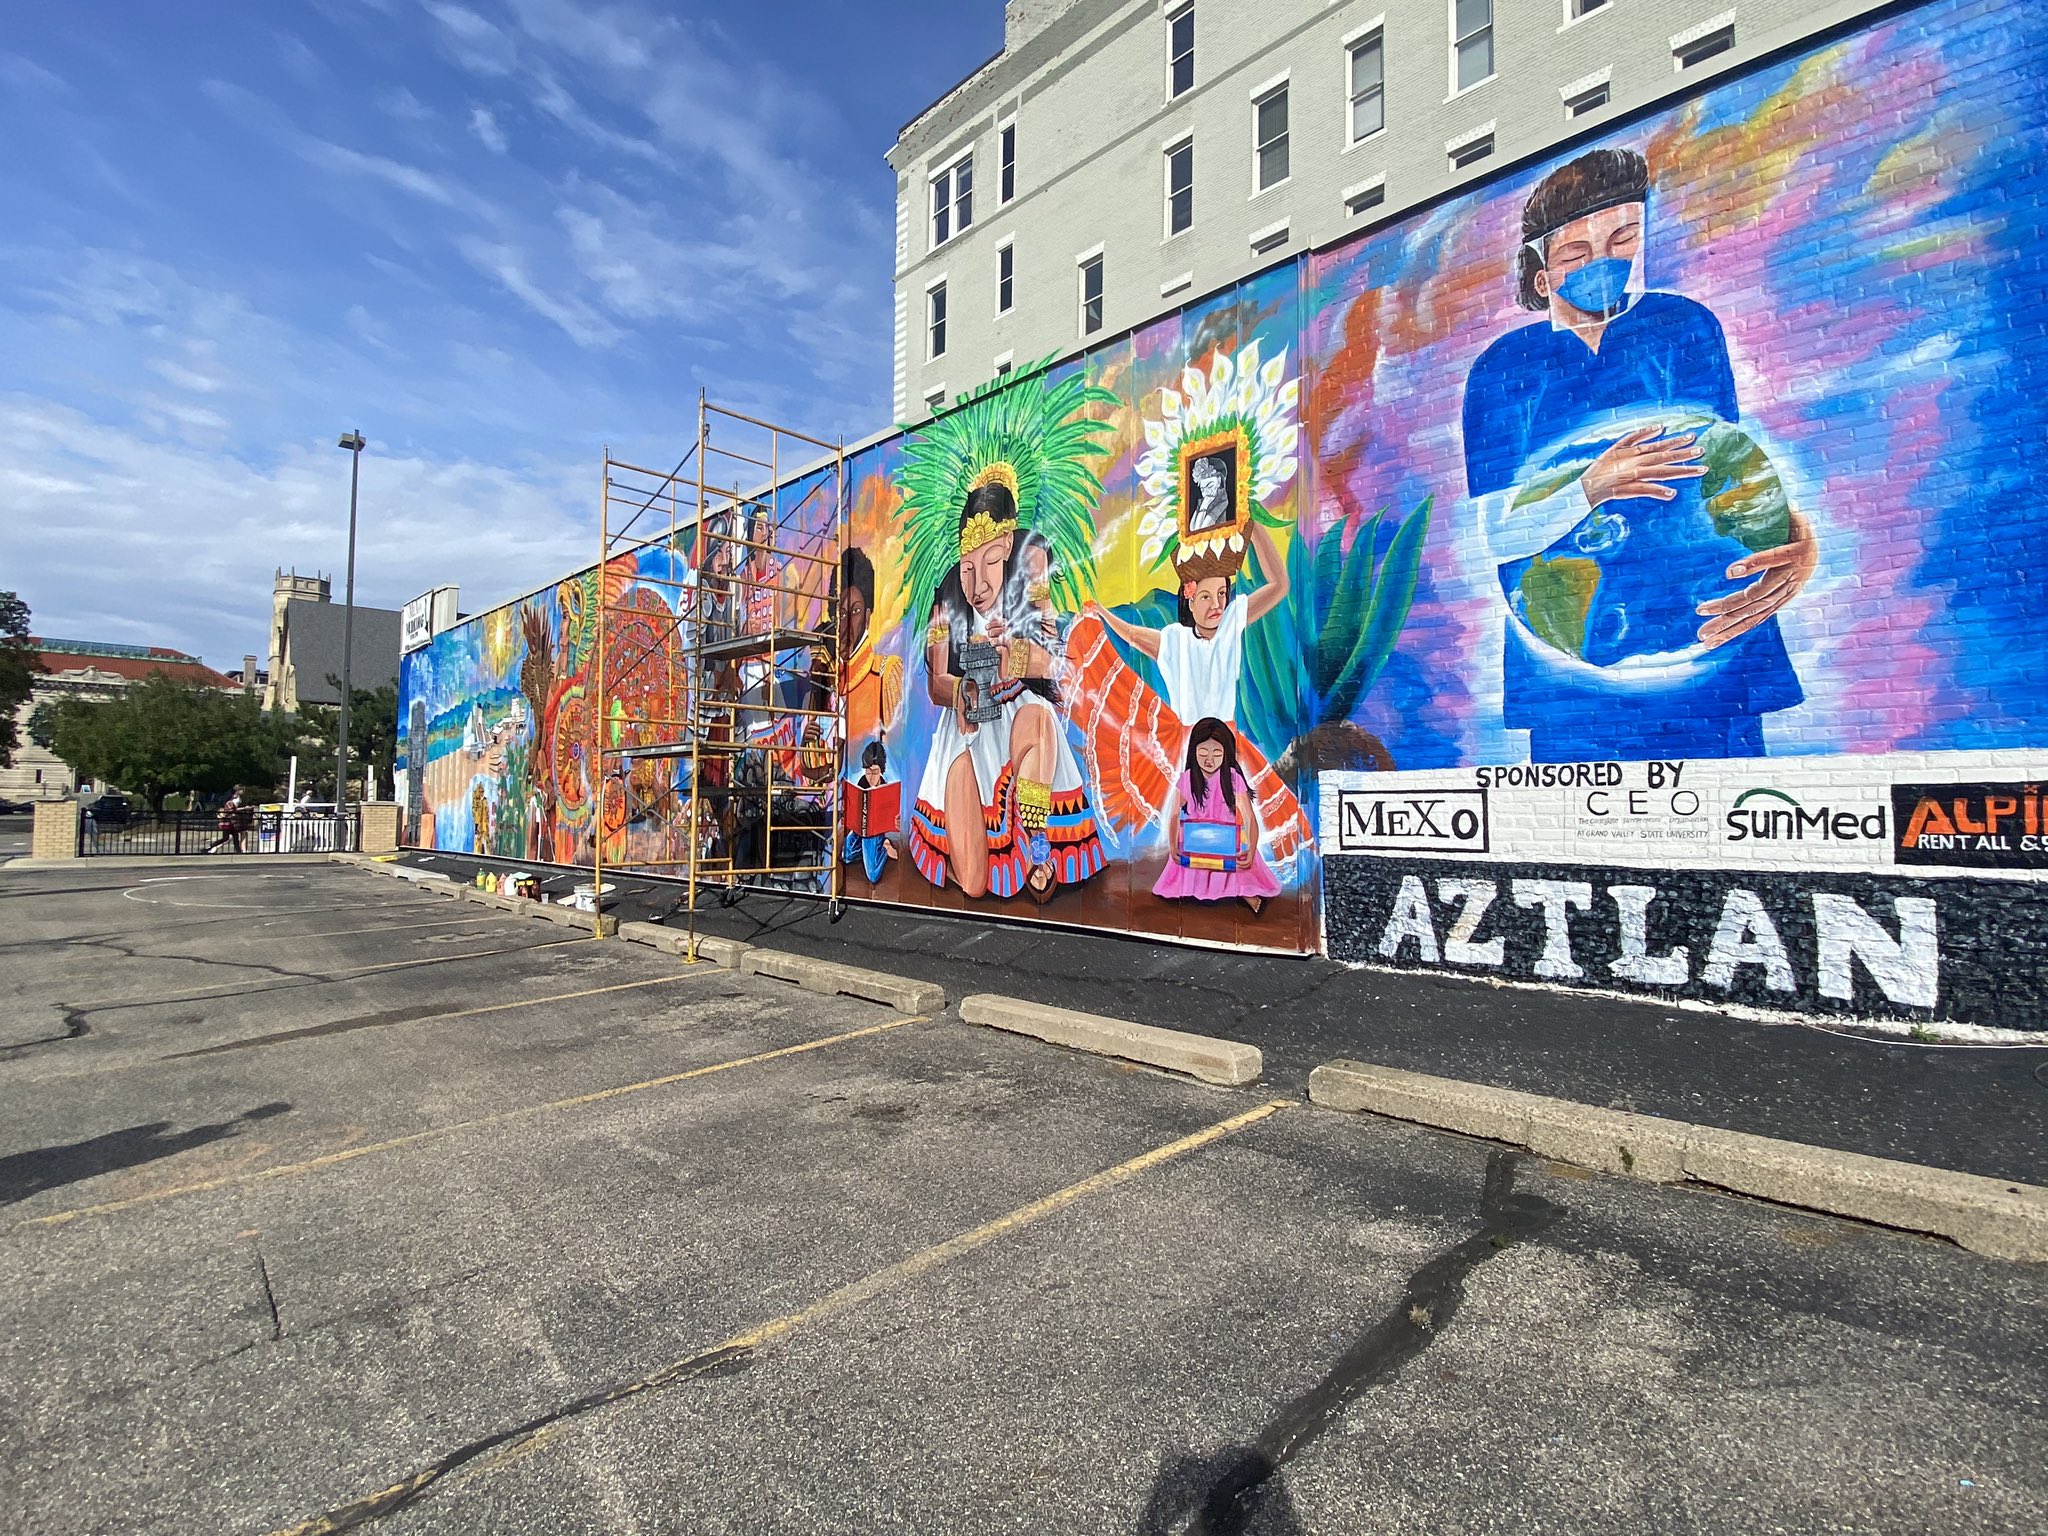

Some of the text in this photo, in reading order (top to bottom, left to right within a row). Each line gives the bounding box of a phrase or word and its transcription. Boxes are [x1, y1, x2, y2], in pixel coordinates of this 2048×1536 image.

[1476, 761, 1685, 789] SPONSORED BY
[1901, 784, 2048, 848] ALPI
[1610, 830, 1635, 838] VALLEY
[1640, 830, 1664, 839] STATE
[1666, 830, 1709, 839] UNIVERSITY
[1918, 834, 1972, 850] RENT
[1974, 835, 2012, 850] ALL
[1377, 874, 1938, 1009] AZTLAN
